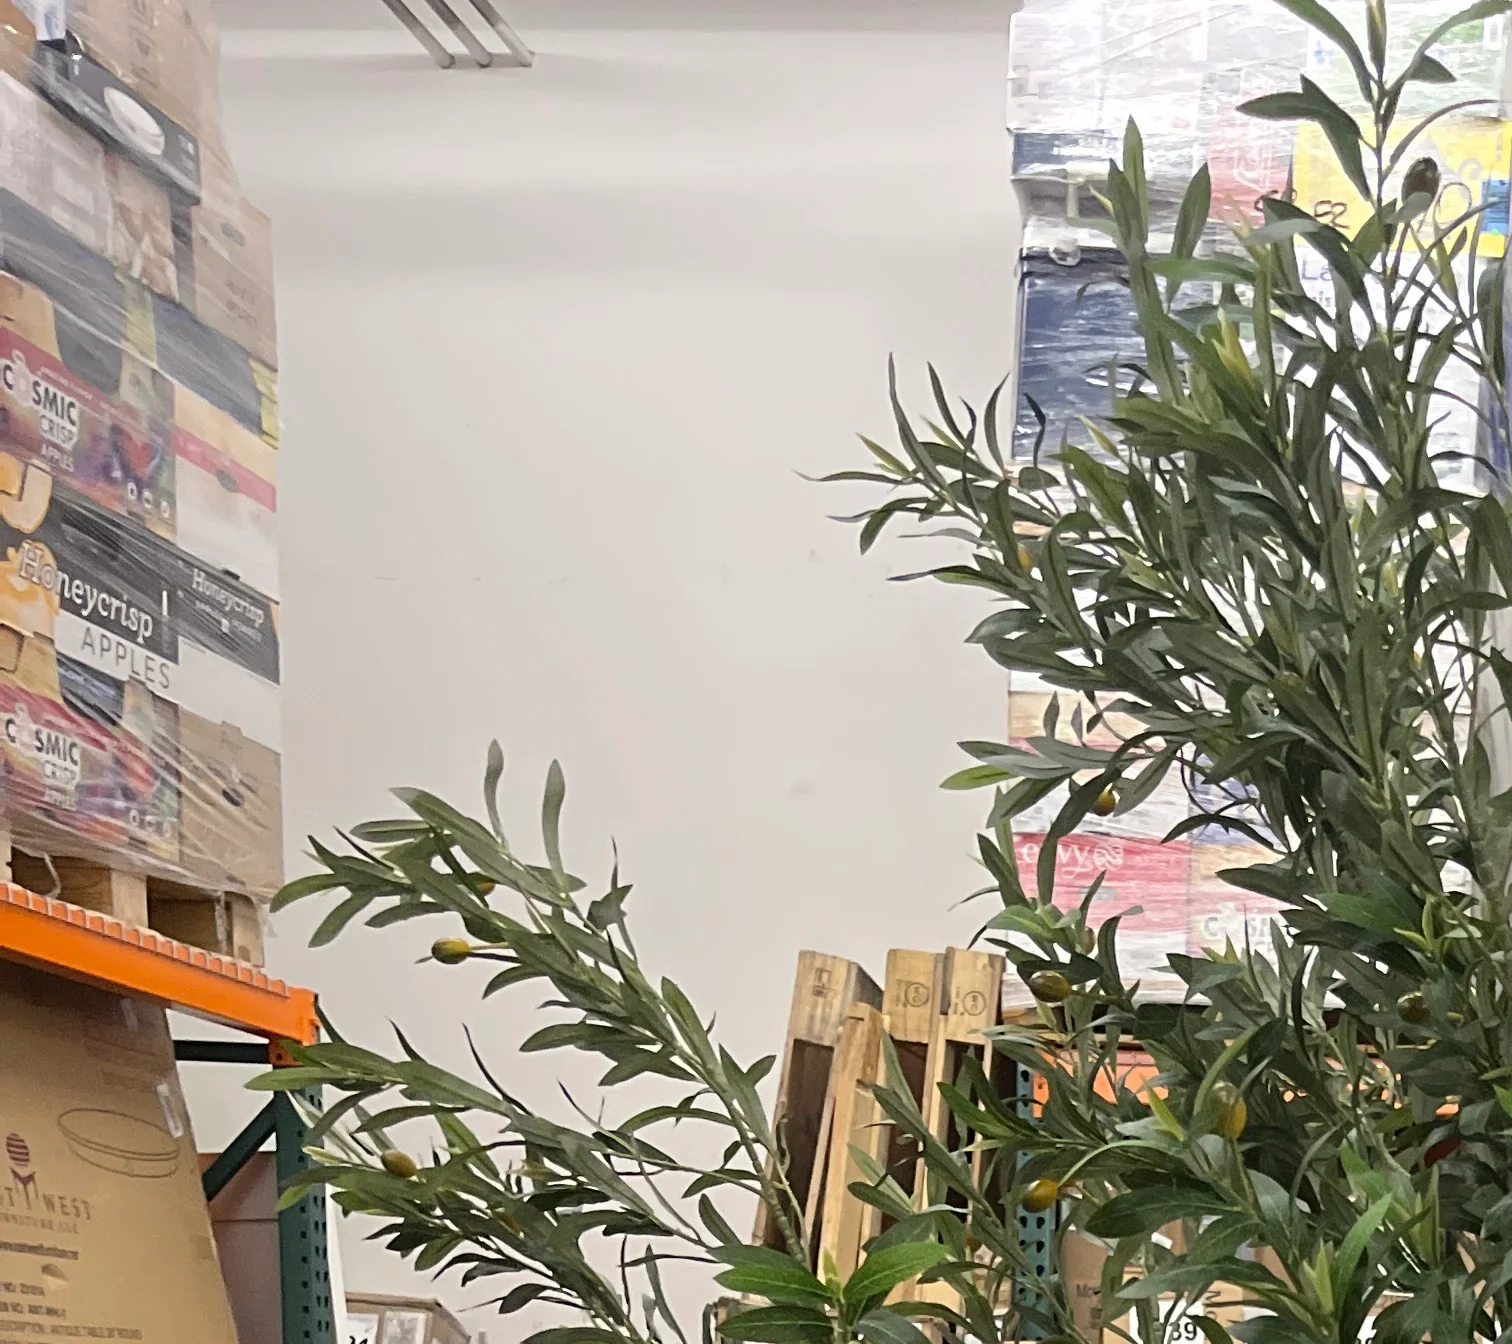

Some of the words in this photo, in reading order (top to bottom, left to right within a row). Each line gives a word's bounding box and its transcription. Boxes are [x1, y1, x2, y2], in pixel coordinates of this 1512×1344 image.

[19, 542, 154, 644] Honeycrisp
[81, 626, 170, 690] APPLES
[1019, 843, 1095, 879] evy
